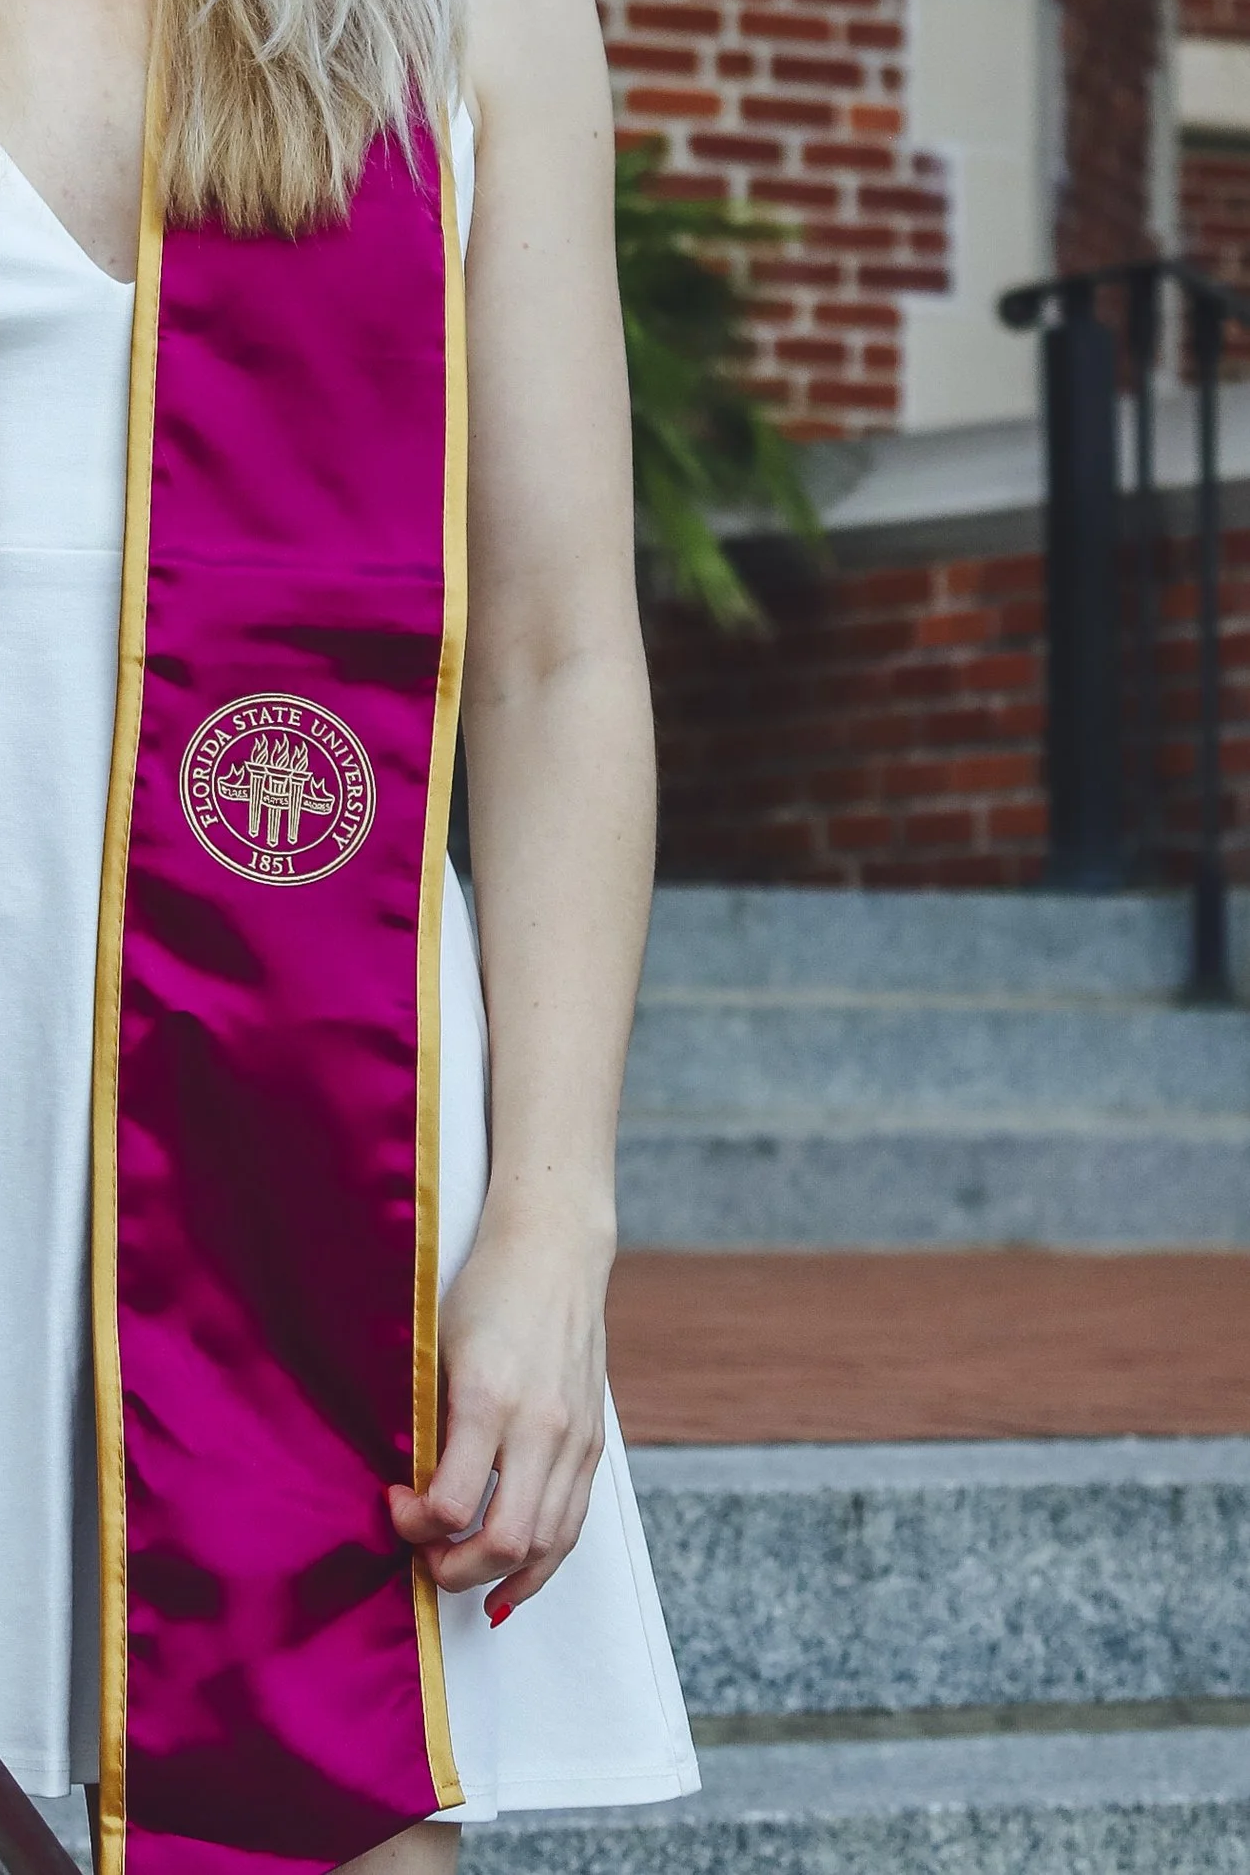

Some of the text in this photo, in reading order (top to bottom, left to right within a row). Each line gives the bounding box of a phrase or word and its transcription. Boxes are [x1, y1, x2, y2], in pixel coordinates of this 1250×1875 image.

[193, 707, 364, 851] FLORIDA STATE UNIVERSITY
[247, 851, 296, 874] 1851
